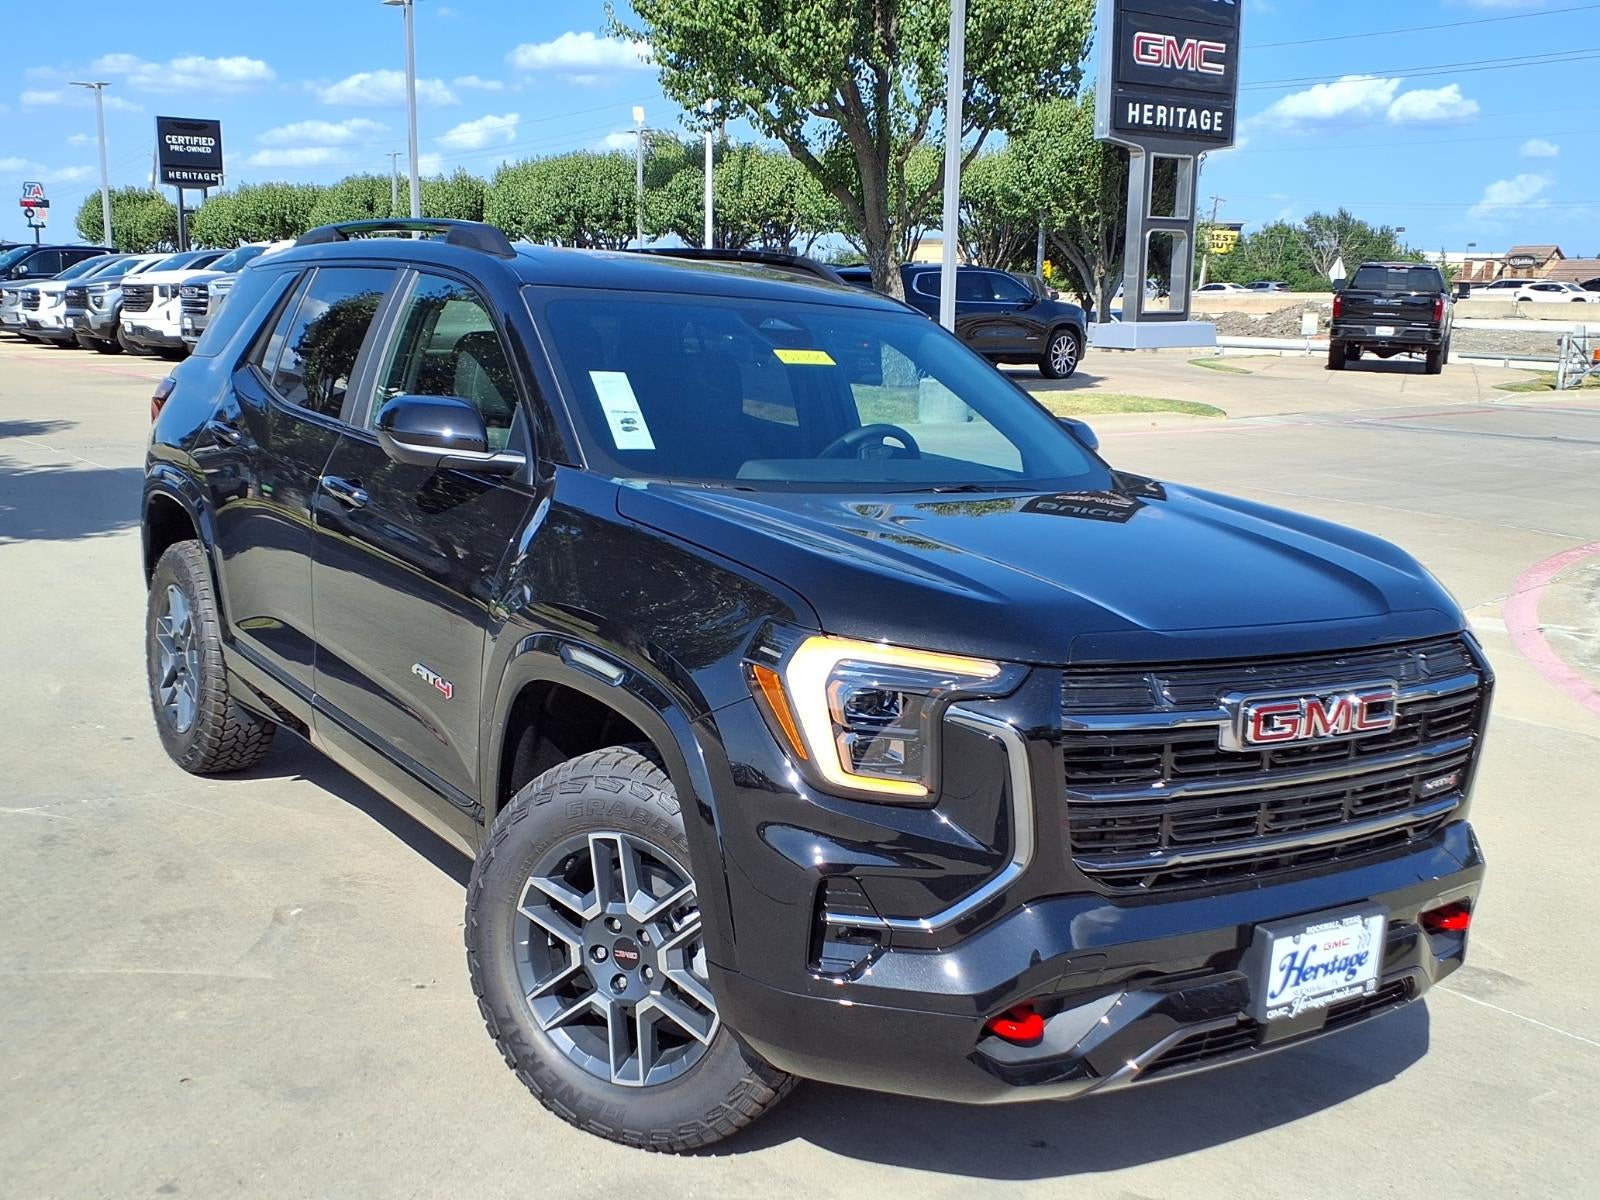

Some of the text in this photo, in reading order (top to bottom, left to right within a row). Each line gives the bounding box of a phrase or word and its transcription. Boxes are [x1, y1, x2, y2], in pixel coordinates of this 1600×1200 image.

[1133, 31, 1227, 75] GMC
[1127, 102, 1223, 131] HERITAGE
[165, 134, 216, 147] CERTIFIED
[169, 144, 212, 154] PRE-OWNED
[168, 170, 217, 181] HERITAGE
[25, 183, 43, 197] TA
[411, 662, 453, 699] AT4
[1249, 691, 1395, 744] GMC
[1323, 937, 1350, 951] GMC
[1269, 944, 1369, 999] Heritage
